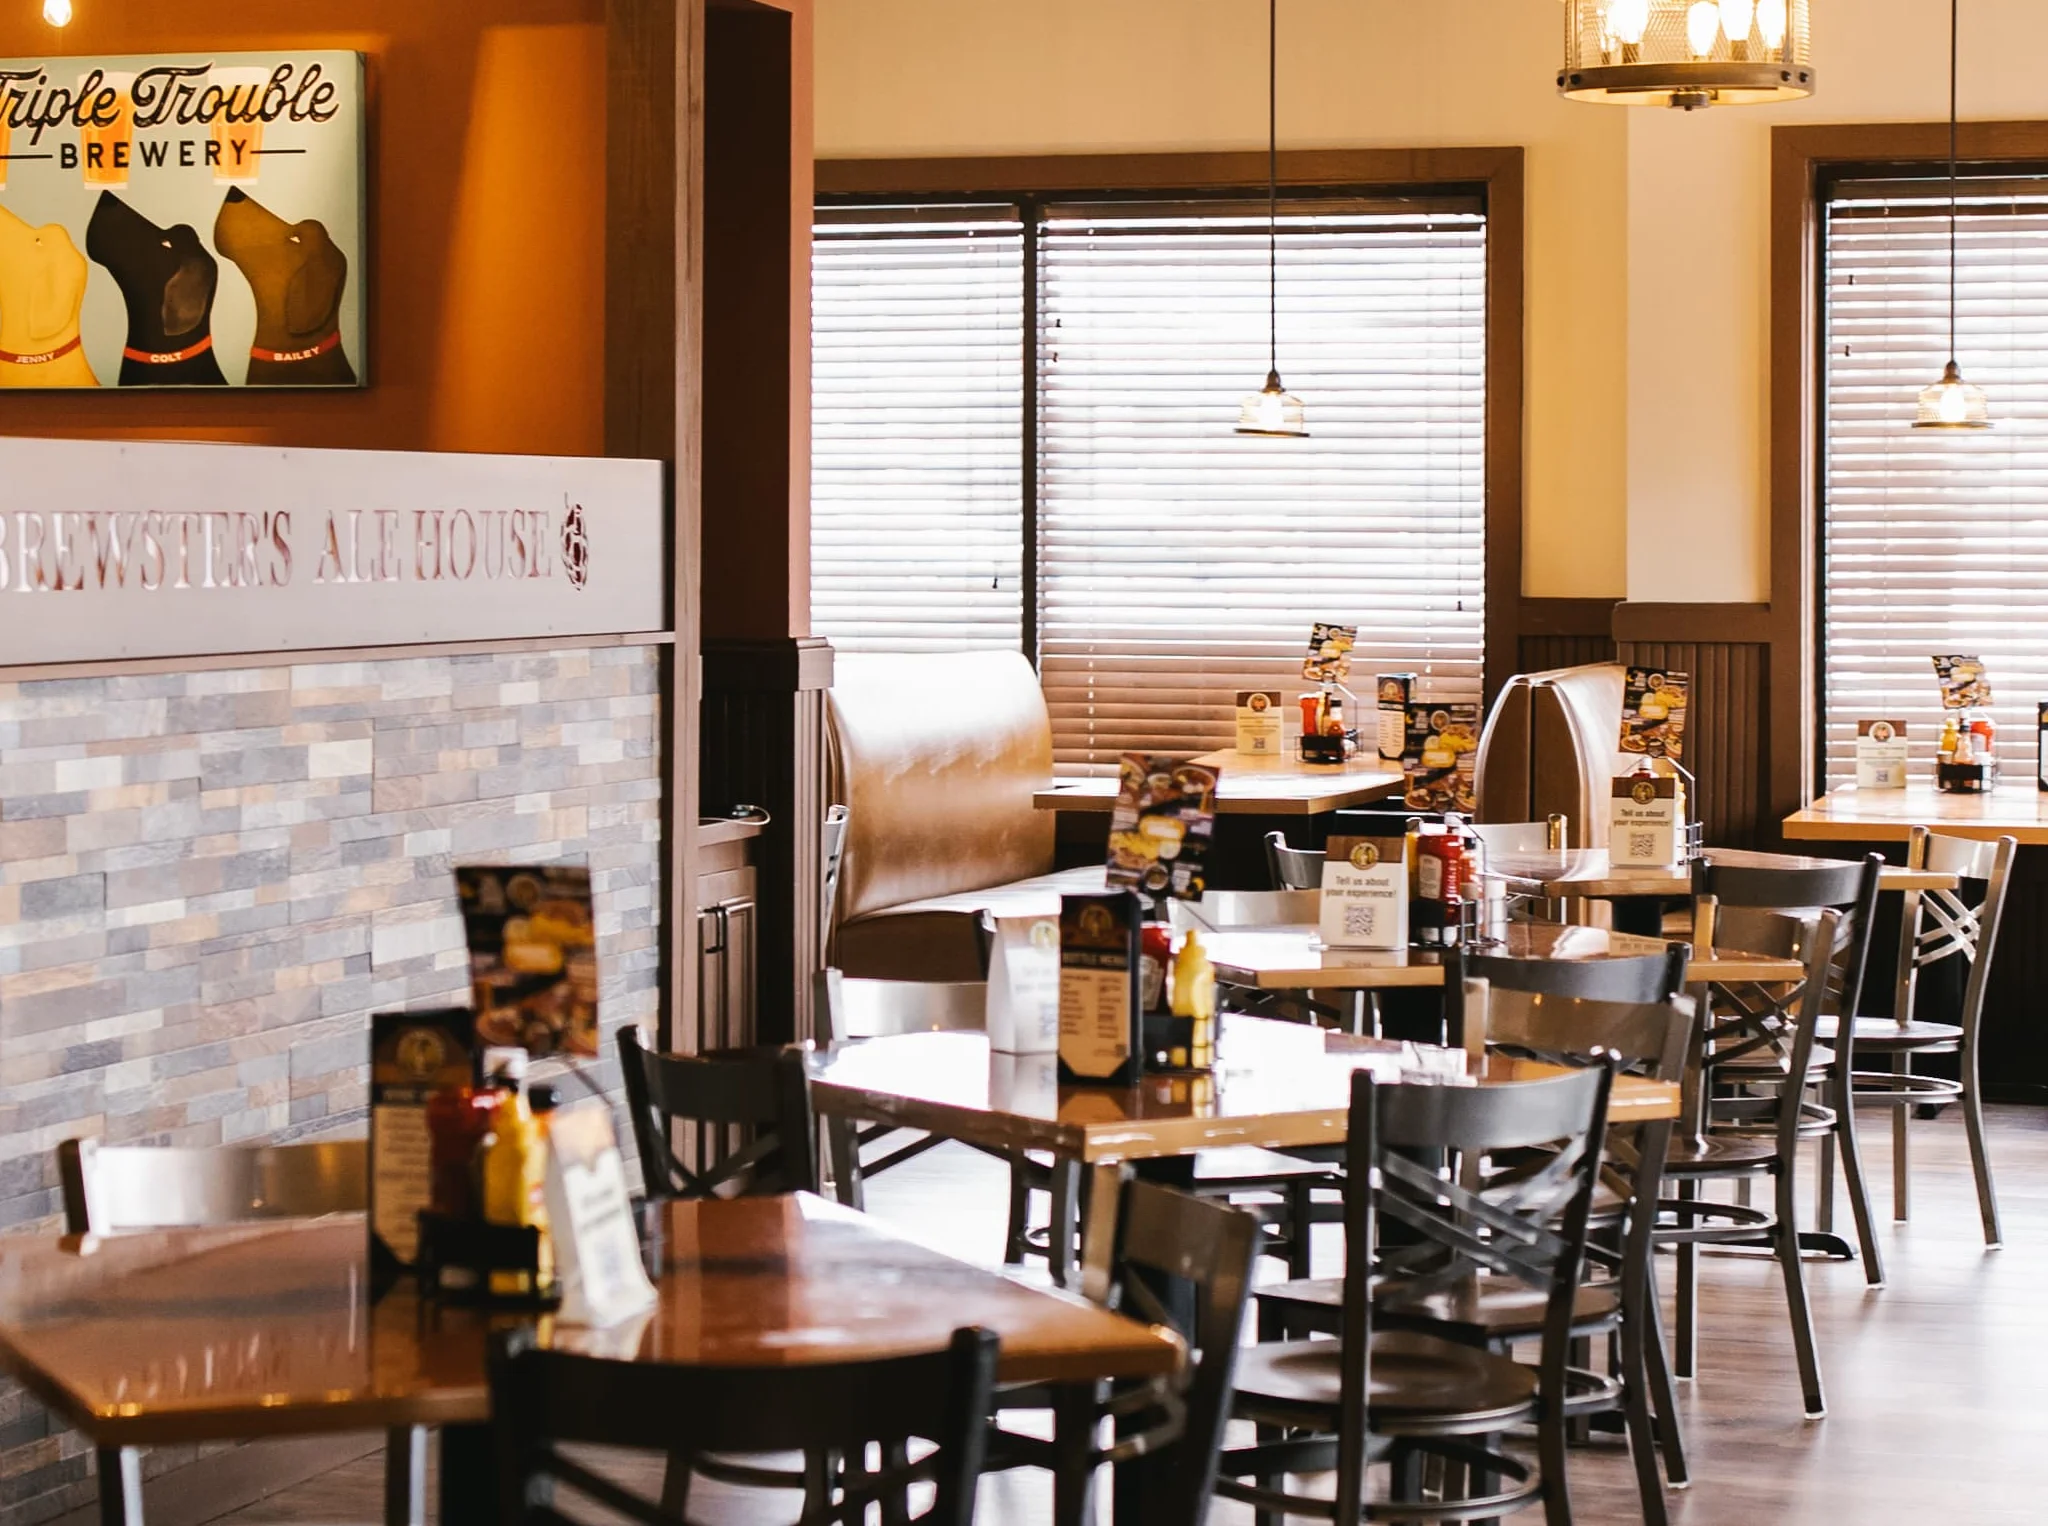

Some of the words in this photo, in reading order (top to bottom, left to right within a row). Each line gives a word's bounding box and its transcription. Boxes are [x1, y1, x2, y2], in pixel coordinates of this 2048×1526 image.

[131, 63, 340, 128] Trouble
[60, 140, 248, 169] BREWERY
[15, 353, 55, 363] JENNY
[150, 352, 182, 363] COLT
[273, 346, 320, 361] BAILEY
[0, 509, 293, 592] REWSTER'S
[312, 509, 401, 584] ALE
[412, 508, 552, 581] HOUSE
[1621, 808, 1633, 816] Tell
[1336, 875, 1350, 885] Tell
[1353, 878, 1363, 886] us
[1365, 878, 1389, 886] about
[1326, 889, 1344, 898] your
[1347, 889, 1397, 899] experience!
